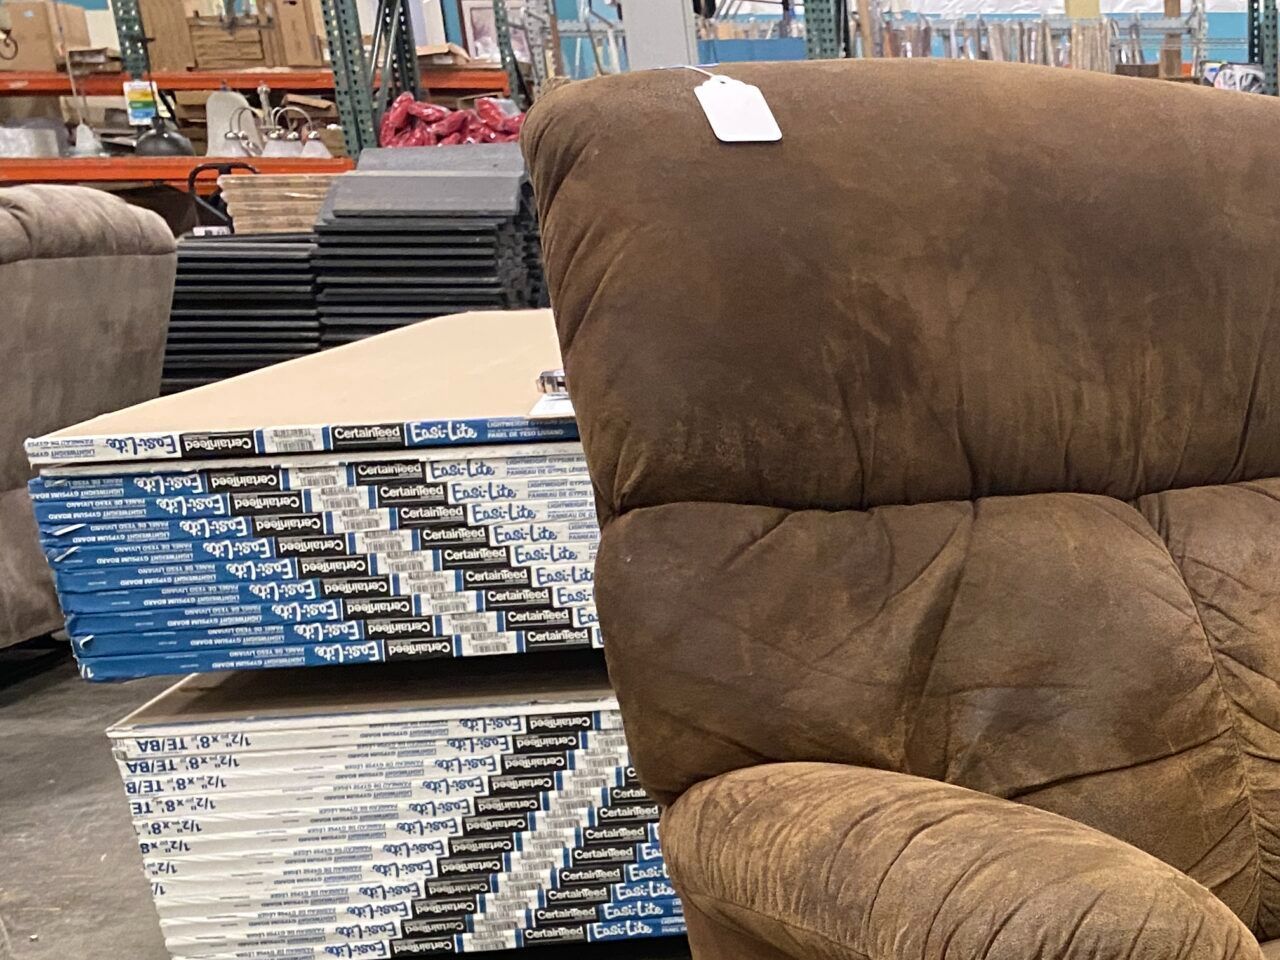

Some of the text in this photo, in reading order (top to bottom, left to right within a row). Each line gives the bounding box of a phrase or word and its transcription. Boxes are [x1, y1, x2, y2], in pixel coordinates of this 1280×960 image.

[334, 426, 400, 439] CertainTeed
[411, 420, 478, 442] Easi-Lite
[106, 434, 177, 456] Easi-Lite
[184, 438, 252, 452] CertainTeed
[358, 462, 422, 475] CertainTeed
[430, 459, 495, 480] Easi-Lite
[134, 474, 203, 495] Easi-Lite
[211, 474, 277, 488] CertainTeed
[380, 484, 444, 498] CertainTeed
[451, 482, 516, 502] Easi-Lite
[156, 495, 225, 516] Easi-Lite
[234, 496, 300, 510] CertainTeed
[400, 506, 464, 518] CertainTeed
[472, 504, 536, 523] Easi-Lite
[180, 516, 248, 538] Easi-Lite
[255, 518, 321, 531] CertainTeed
[423, 527, 485, 540] CertainTeed
[494, 524, 557, 544] Easi-Lite
[203, 538, 270, 559] Easi-Lite
[279, 540, 344, 553] CertainTeed
[444, 547, 506, 560] CertainTeed
[514, 543, 577, 564] Easi-Lite
[226, 559, 294, 580] Easi-Lite
[302, 560, 366, 574] CertainTeed
[466, 569, 528, 582] CertainTeed
[249, 580, 316, 601] Easi-Lite
[324, 581, 388, 594] CertainTeed
[488, 589, 549, 602] CertainTeed
[556, 586, 594, 605] Easi-
[272, 600, 338, 621] Easi-Lite
[347, 602, 410, 614] CertainTeed
[508, 609, 569, 622] CertainTeed
[294, 620, 360, 642] Easi-Lite
[368, 622, 430, 635] CertainTeed
[527, 628, 588, 642] CertainTeed
[314, 641, 380, 663] Easi-Lite
[388, 642, 450, 656] CertainTeed
[459, 716, 522, 734] Easi-Lite
[530, 717, 590, 729] CertainTeed
[136, 738, 188, 752] TE/BA
[447, 736, 510, 753] Easi-Lite
[516, 736, 576, 748] CertainTeed
[126, 759, 177, 774] TE/BA
[435, 756, 497, 774] Easi-Lite
[505, 756, 564, 769] CertainTeed
[423, 776, 484, 794] Easi-Lite
[492, 778, 552, 790] CertainTeed
[409, 799, 470, 817] Easi-Lite
[479, 800, 538, 812] CertainTeed
[600, 806, 658, 818] CertainTeed
[397, 818, 459, 836] Easi-Lite
[466, 818, 525, 831] CertainTeed
[586, 827, 644, 839] CertainTeed
[383, 840, 445, 858] Easi-Lite
[452, 841, 512, 853] CertainTeed
[574, 847, 633, 859] CertainTeed
[372, 860, 434, 878] Easi-Lite
[442, 860, 500, 873] CertainTeed
[562, 868, 620, 880] CertainTeed
[359, 882, 421, 900] Easi-Lite
[429, 882, 488, 895] CertainTeed
[548, 887, 607, 900] CertainTeed
[615, 881, 676, 900] Easi-Lite
[347, 902, 409, 920] Easi-Lite
[416, 902, 474, 914] CertainTeed
[537, 907, 596, 920] CertainTeed
[604, 900, 664, 920] Easi-Lite
[336, 922, 396, 939] Easi-Lite
[405, 922, 464, 934] CertainTeed
[525, 926, 584, 938] CertainTeed
[593, 920, 652, 939] Easi-Lite
[325, 940, 386, 959] Easi-Lite
[394, 941, 452, 954] CertainTeed
